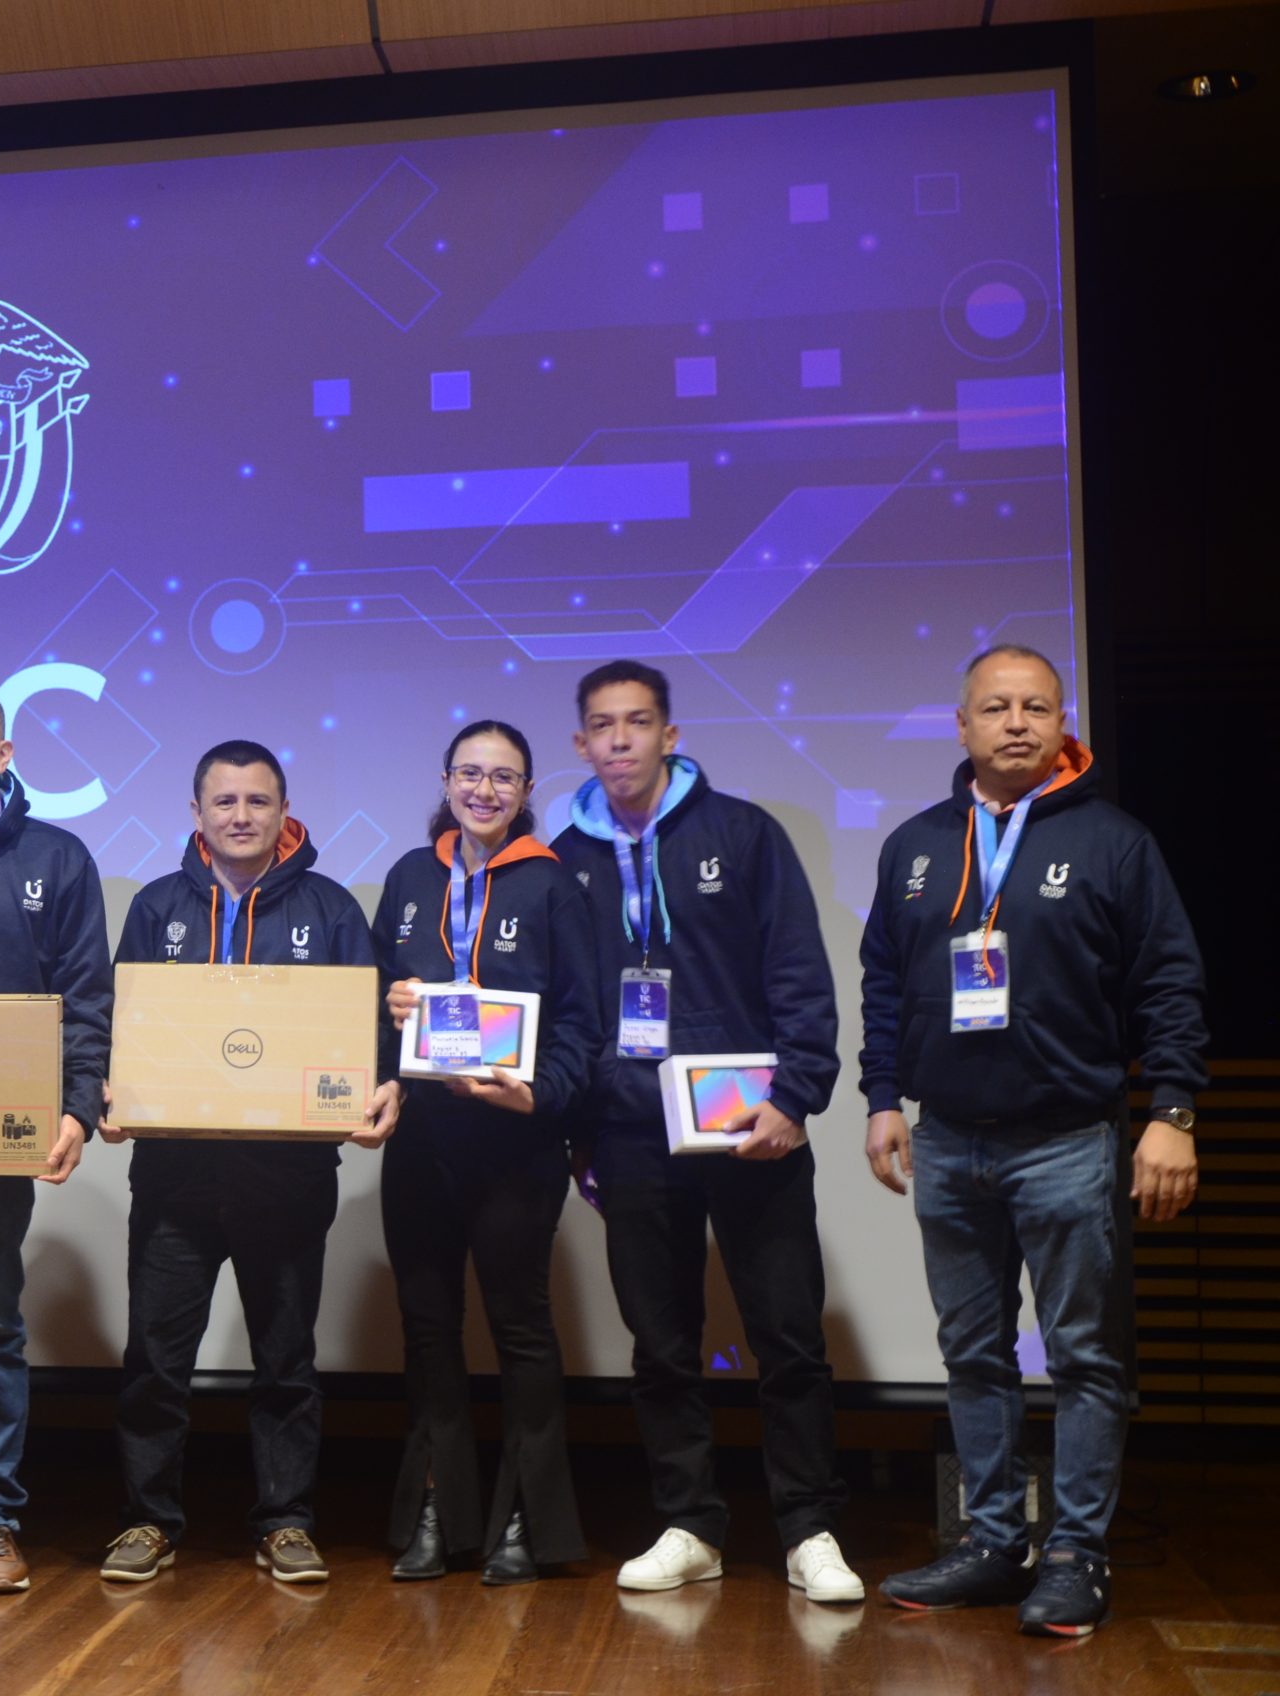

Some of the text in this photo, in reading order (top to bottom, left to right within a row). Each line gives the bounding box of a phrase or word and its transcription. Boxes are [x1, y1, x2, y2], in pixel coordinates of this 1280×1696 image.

[400, 924, 412, 936] TIC
[448, 1007, 461, 1015] TIC
[227, 1043, 259, 1054] DELL
[317, 1101, 352, 1110] UN3481
[2, 1141, 37, 1150] UN3481
